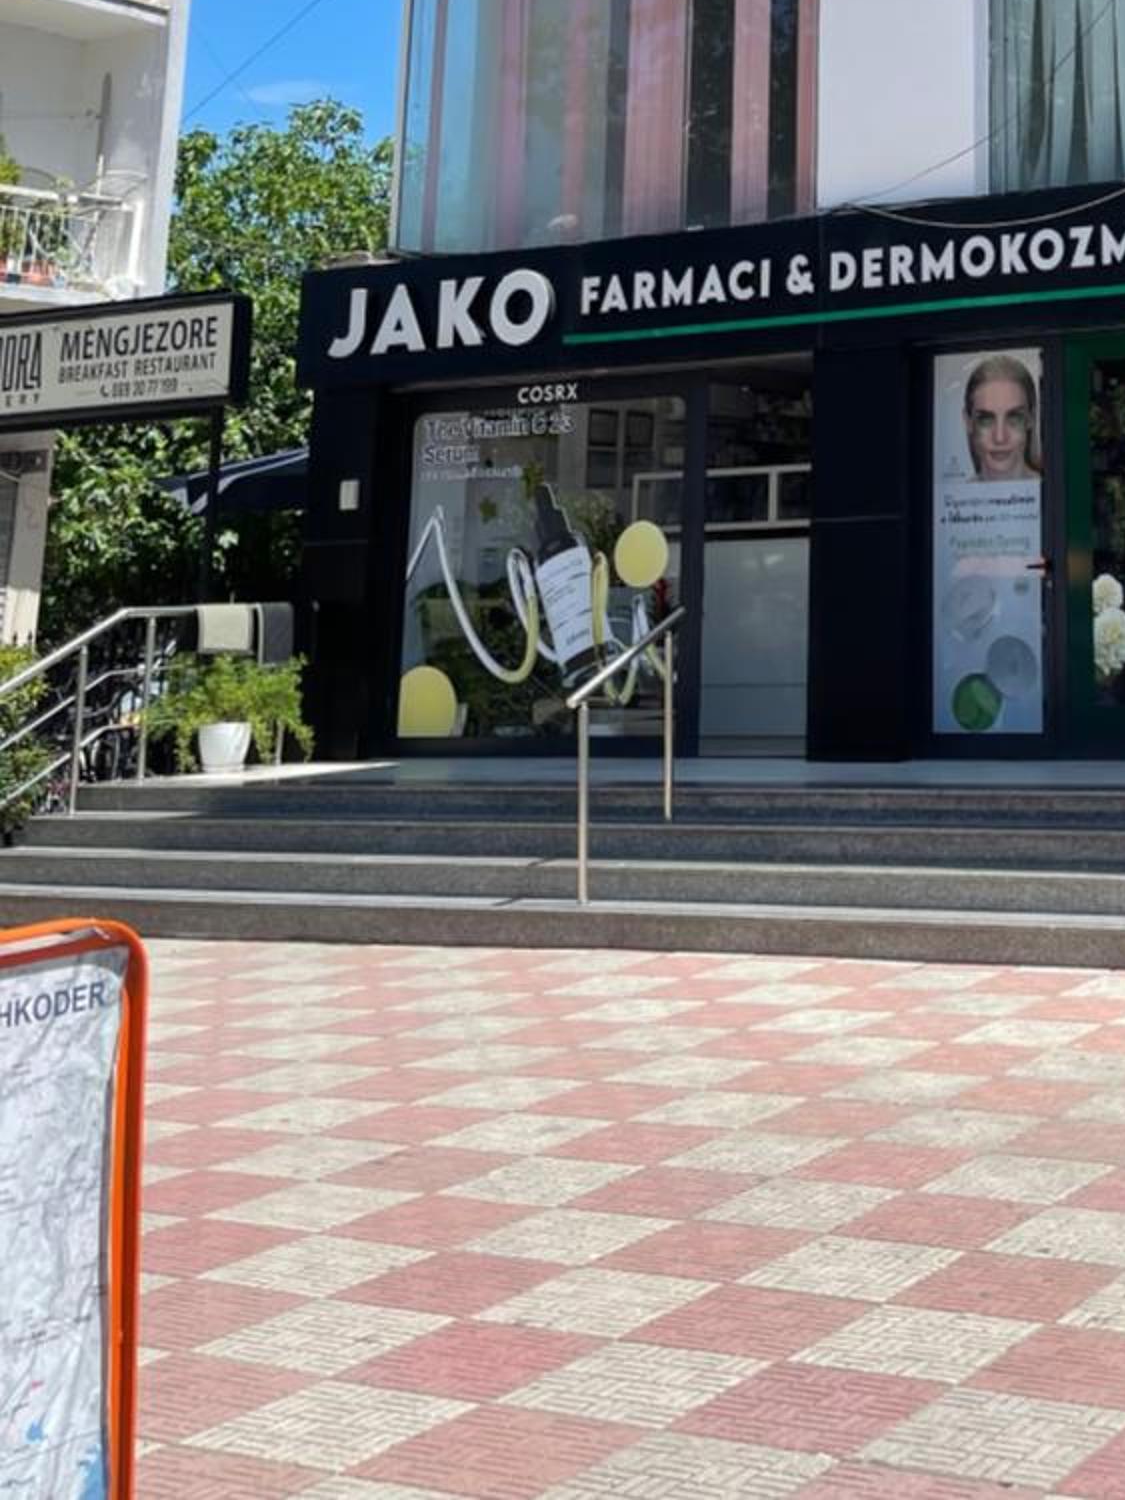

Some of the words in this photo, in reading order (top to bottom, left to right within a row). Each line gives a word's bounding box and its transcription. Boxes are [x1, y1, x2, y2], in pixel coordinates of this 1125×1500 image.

[328, 268, 556, 358] JAKO
[580, 258, 772, 315] FARMACI
[786, 253, 815, 295] &
[58, 361, 129, 384] BREAKFAST
[134, 352, 217, 376] RESTAURANT
[517, 383, 578, 404] COSRX
